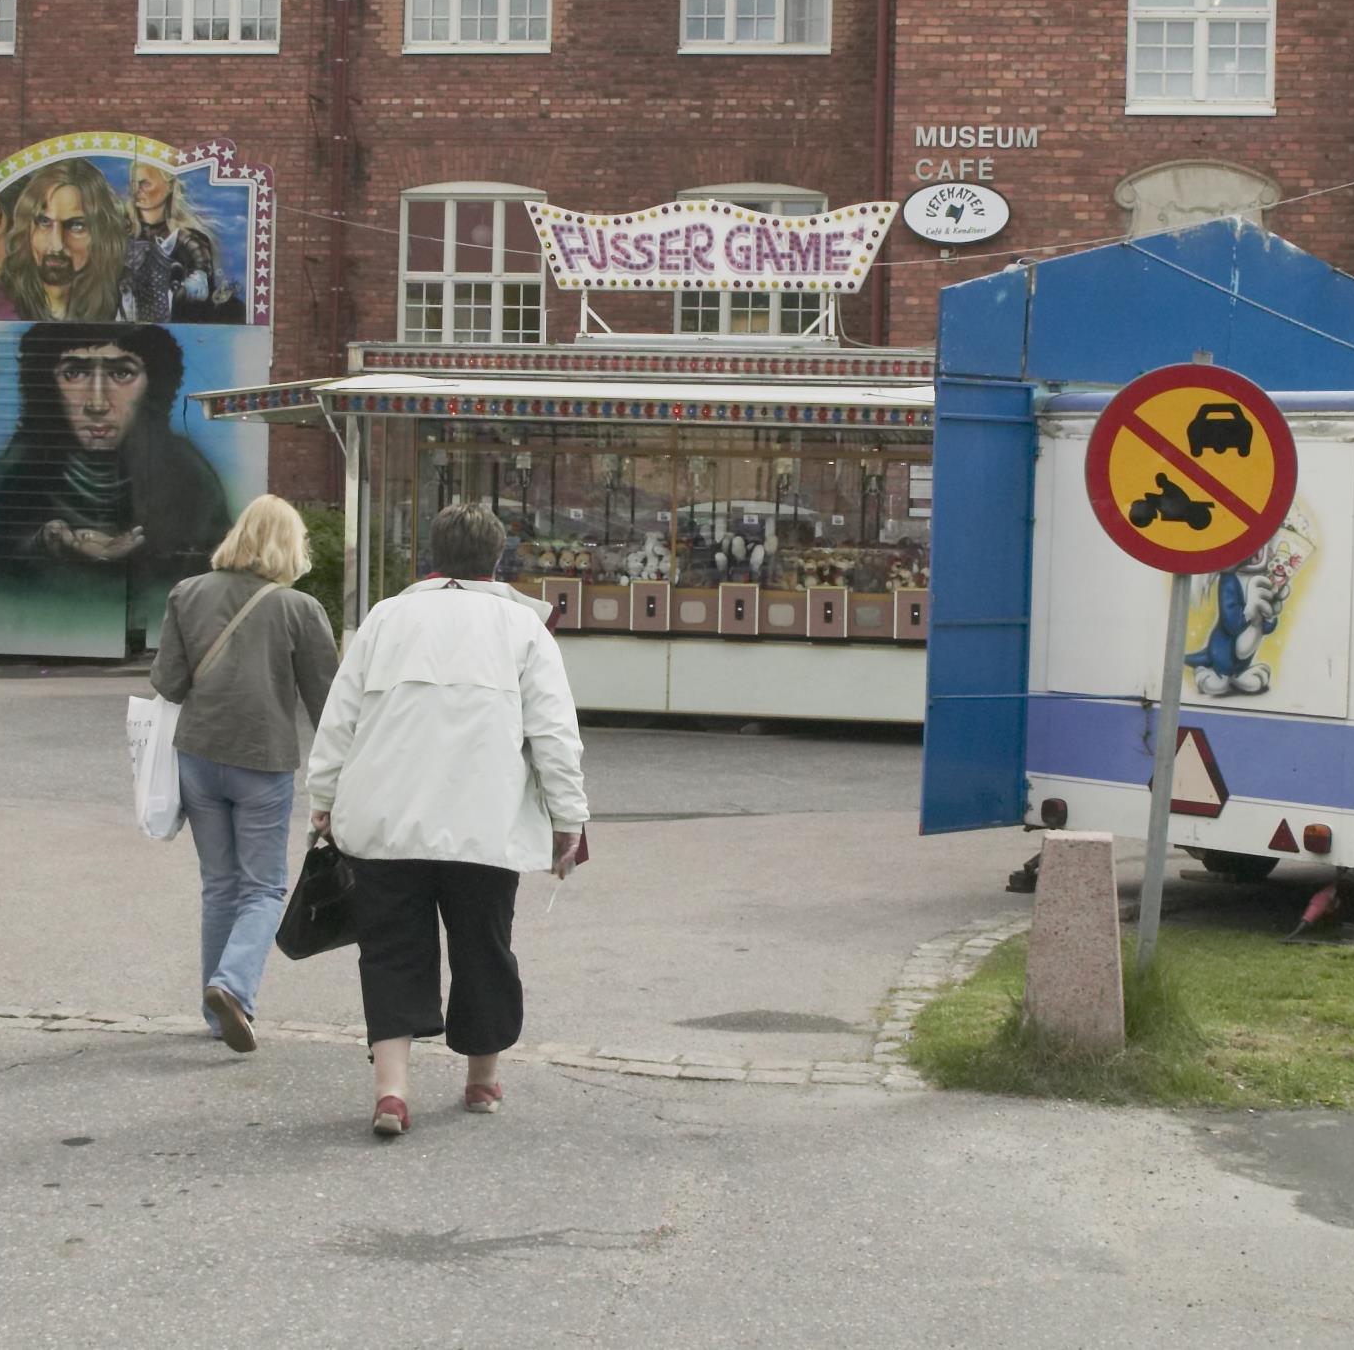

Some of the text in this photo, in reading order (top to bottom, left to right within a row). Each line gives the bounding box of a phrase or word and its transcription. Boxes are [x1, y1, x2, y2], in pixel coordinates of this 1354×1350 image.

[915, 125, 1038, 148] MUSEUM
[915, 156, 994, 180] CAFÉ
[926, 187, 985, 218] VETEHATTEN
[724, 223, 852, 273] GAME
